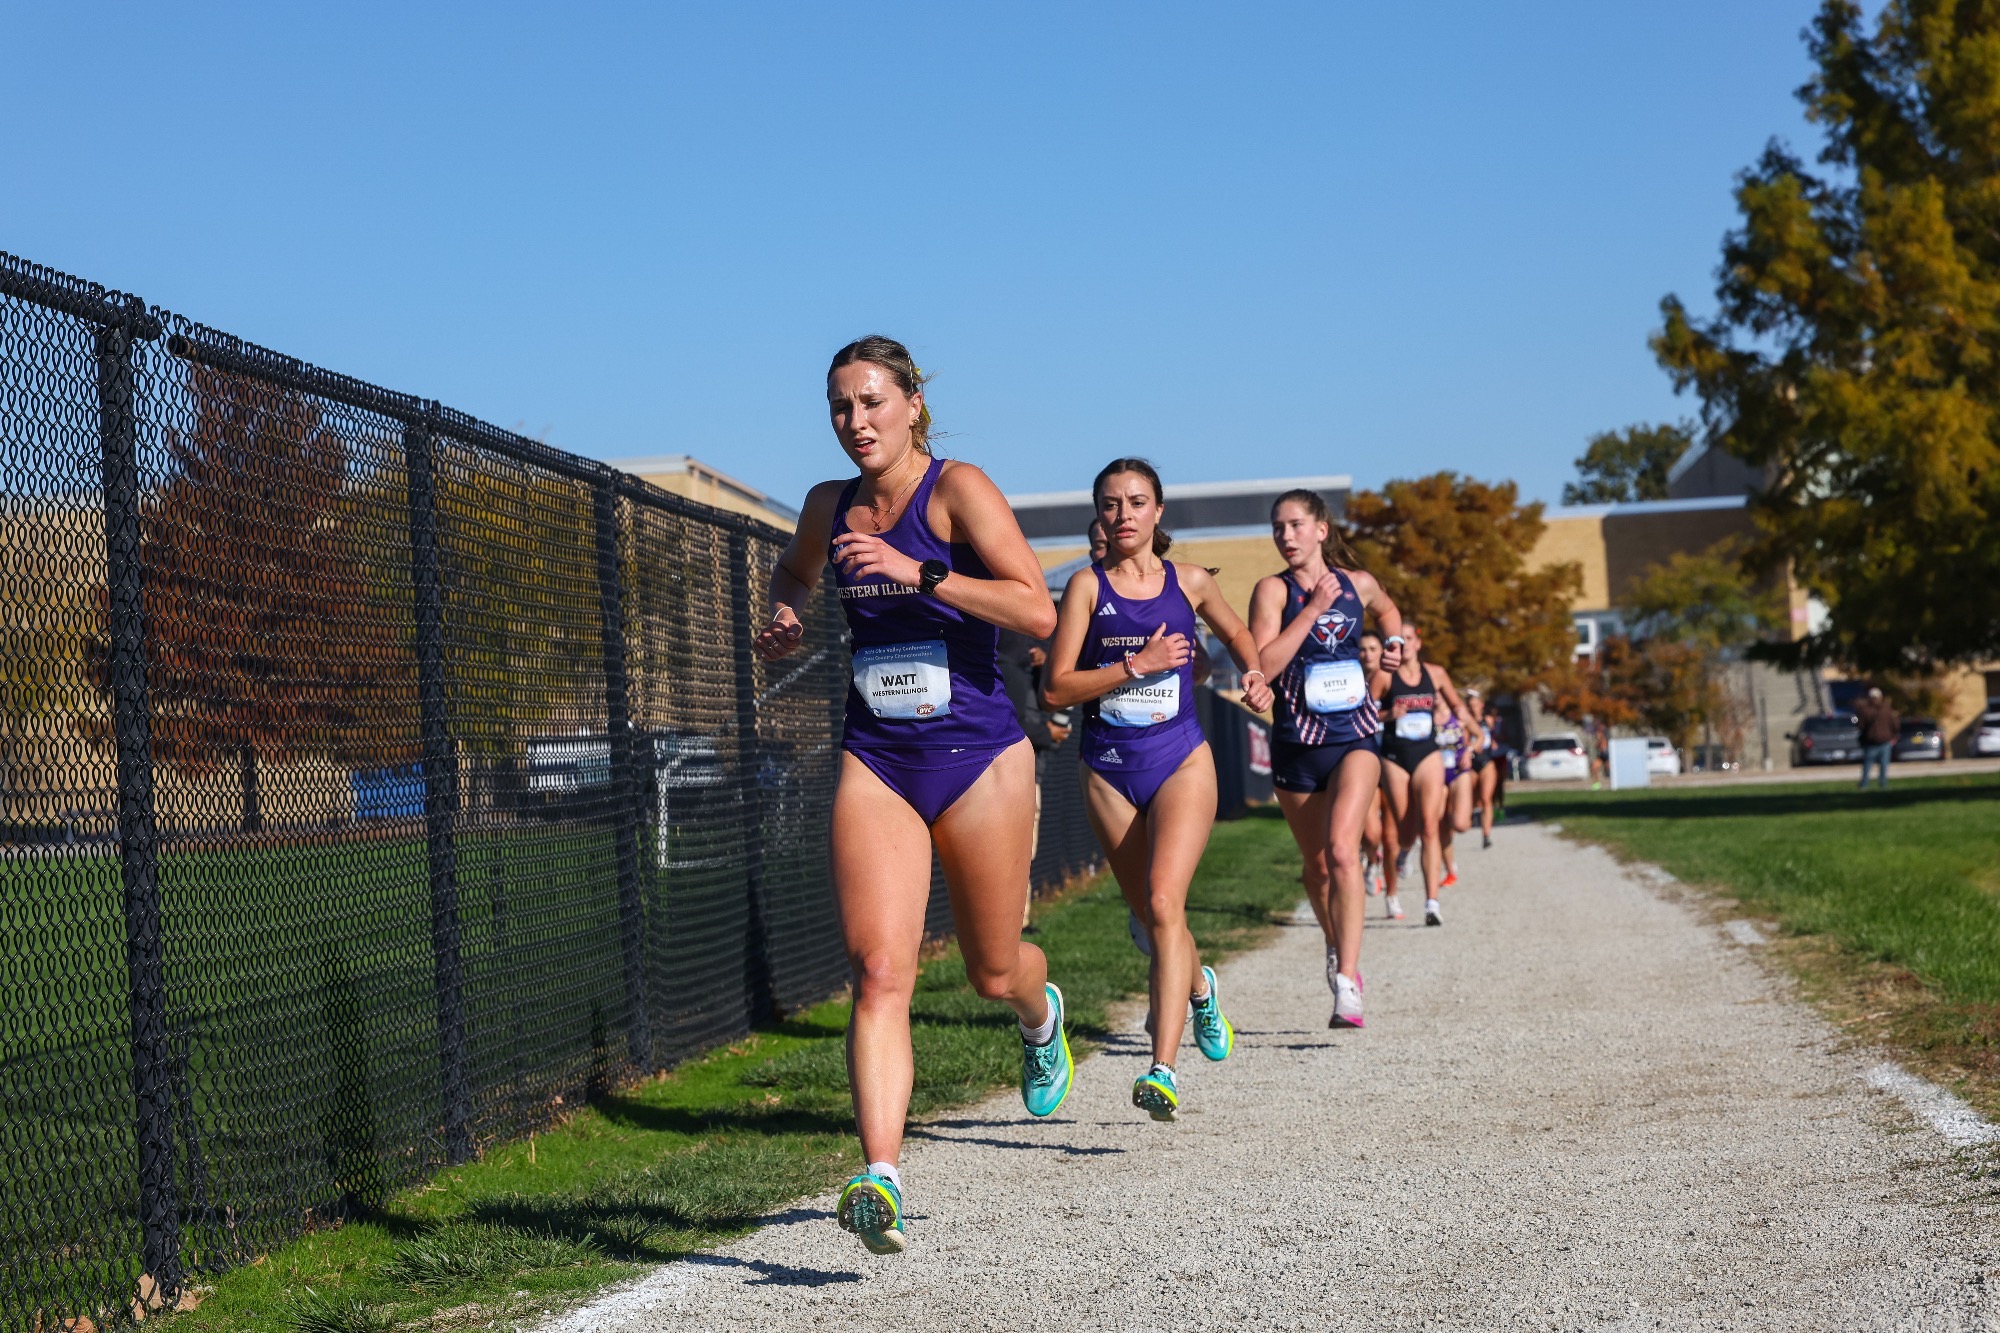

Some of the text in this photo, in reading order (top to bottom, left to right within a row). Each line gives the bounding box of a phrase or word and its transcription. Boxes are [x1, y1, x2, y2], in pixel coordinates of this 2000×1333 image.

[1101, 636, 1145, 647] WESTERN
[902, 644, 932, 652] Conference
[880, 673, 917, 687] WATT
[1323, 679, 1347, 688] SETTLE
[872, 686, 928, 697] WESTERN ILLINOIS
[1100, 755, 1122, 764] adidas
